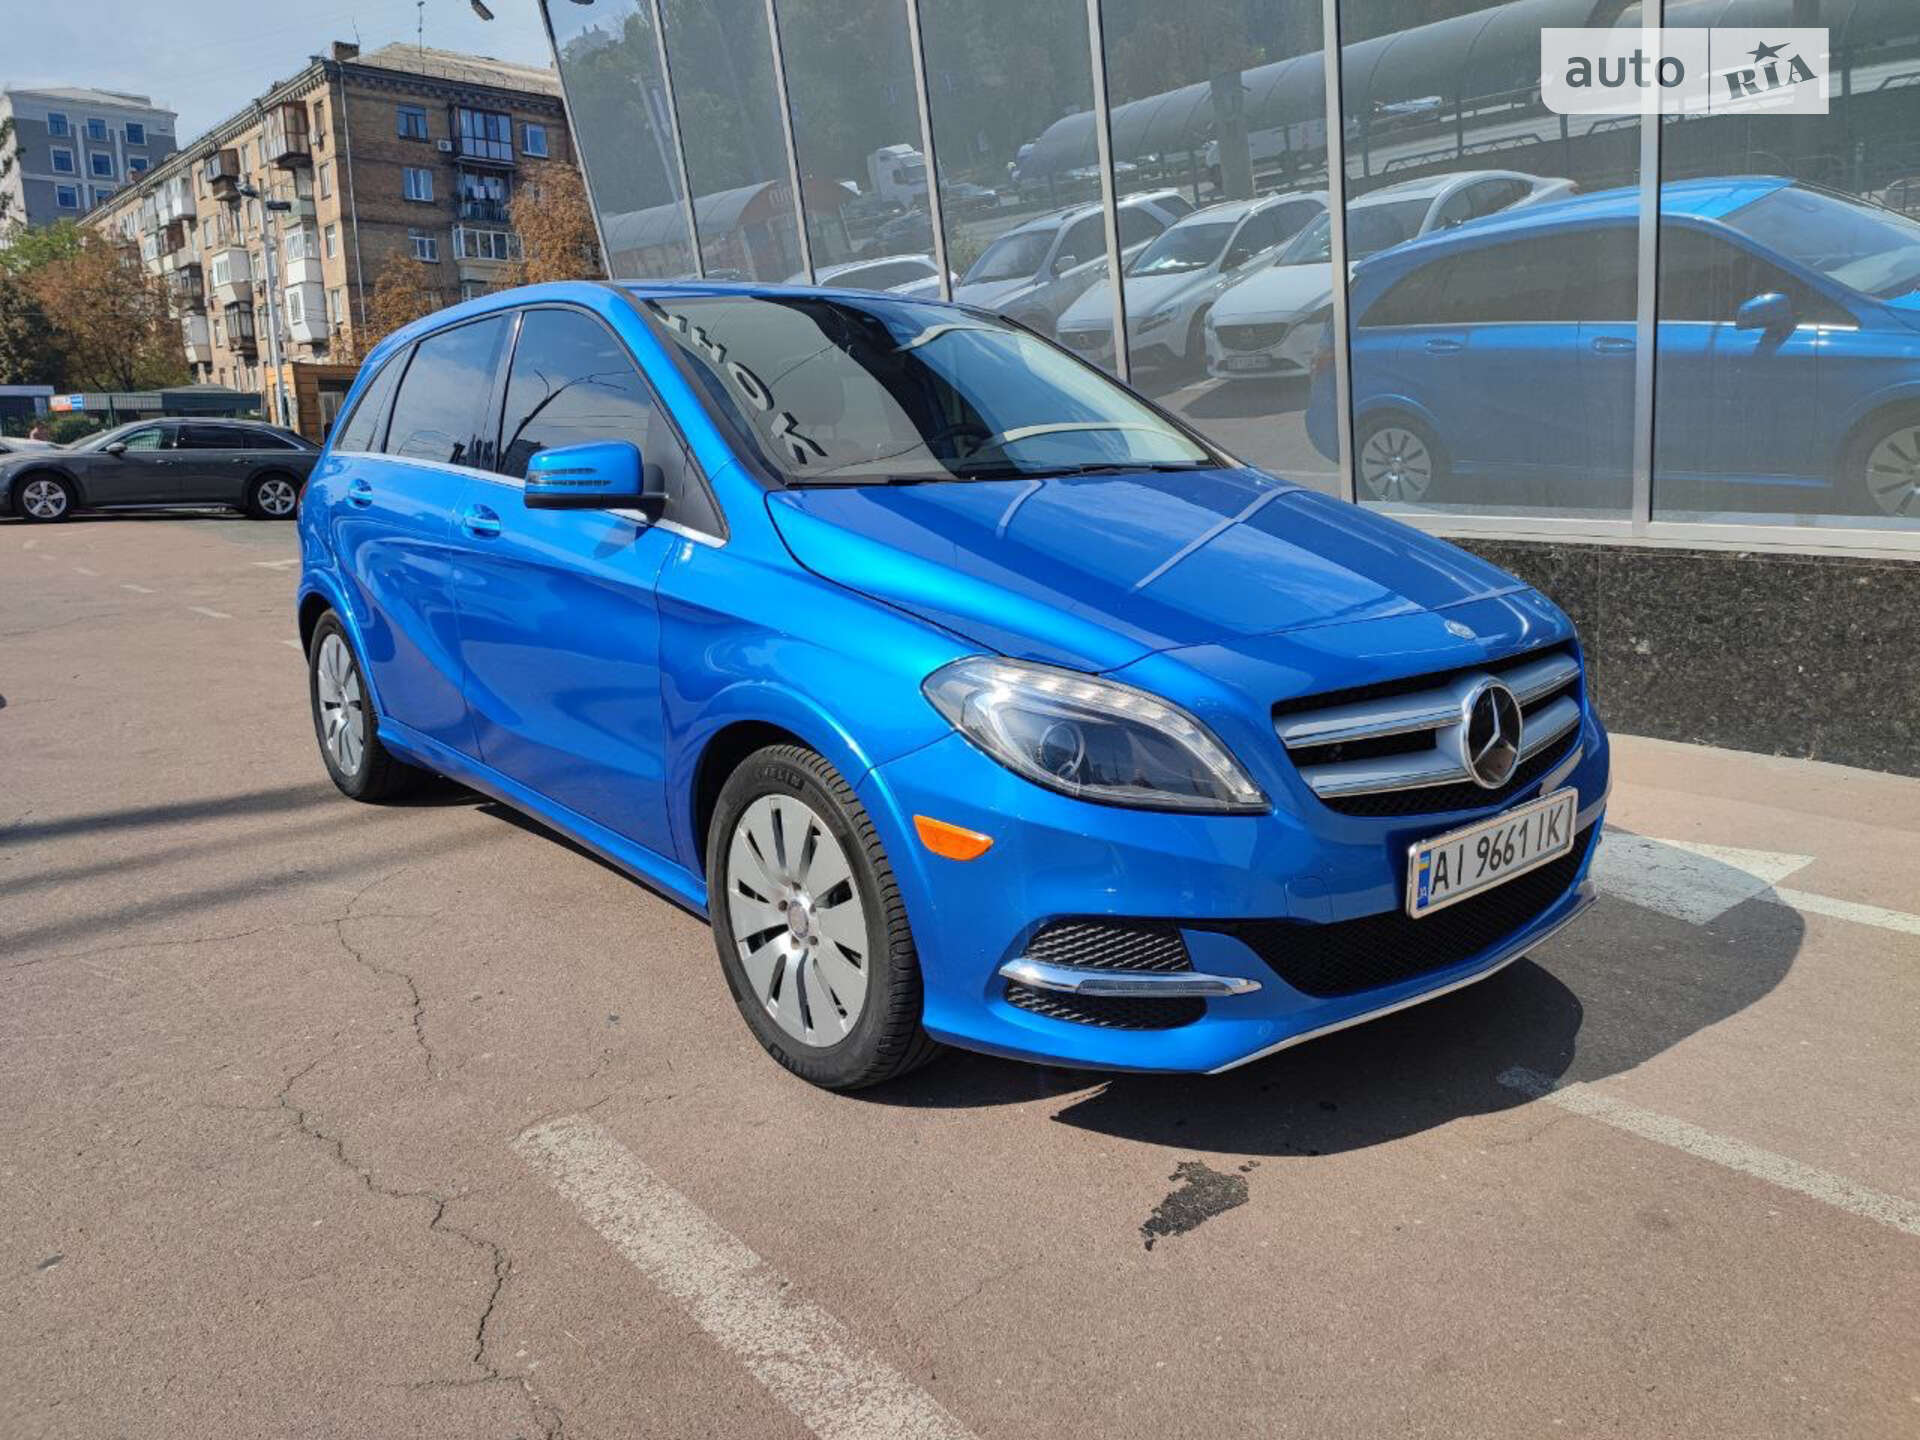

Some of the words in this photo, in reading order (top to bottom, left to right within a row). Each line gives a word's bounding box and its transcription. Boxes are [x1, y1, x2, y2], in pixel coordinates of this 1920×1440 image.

[1431, 844, 1464, 895] AI
[1476, 819, 1528, 878] 9661
[1537, 804, 1564, 852] IK
